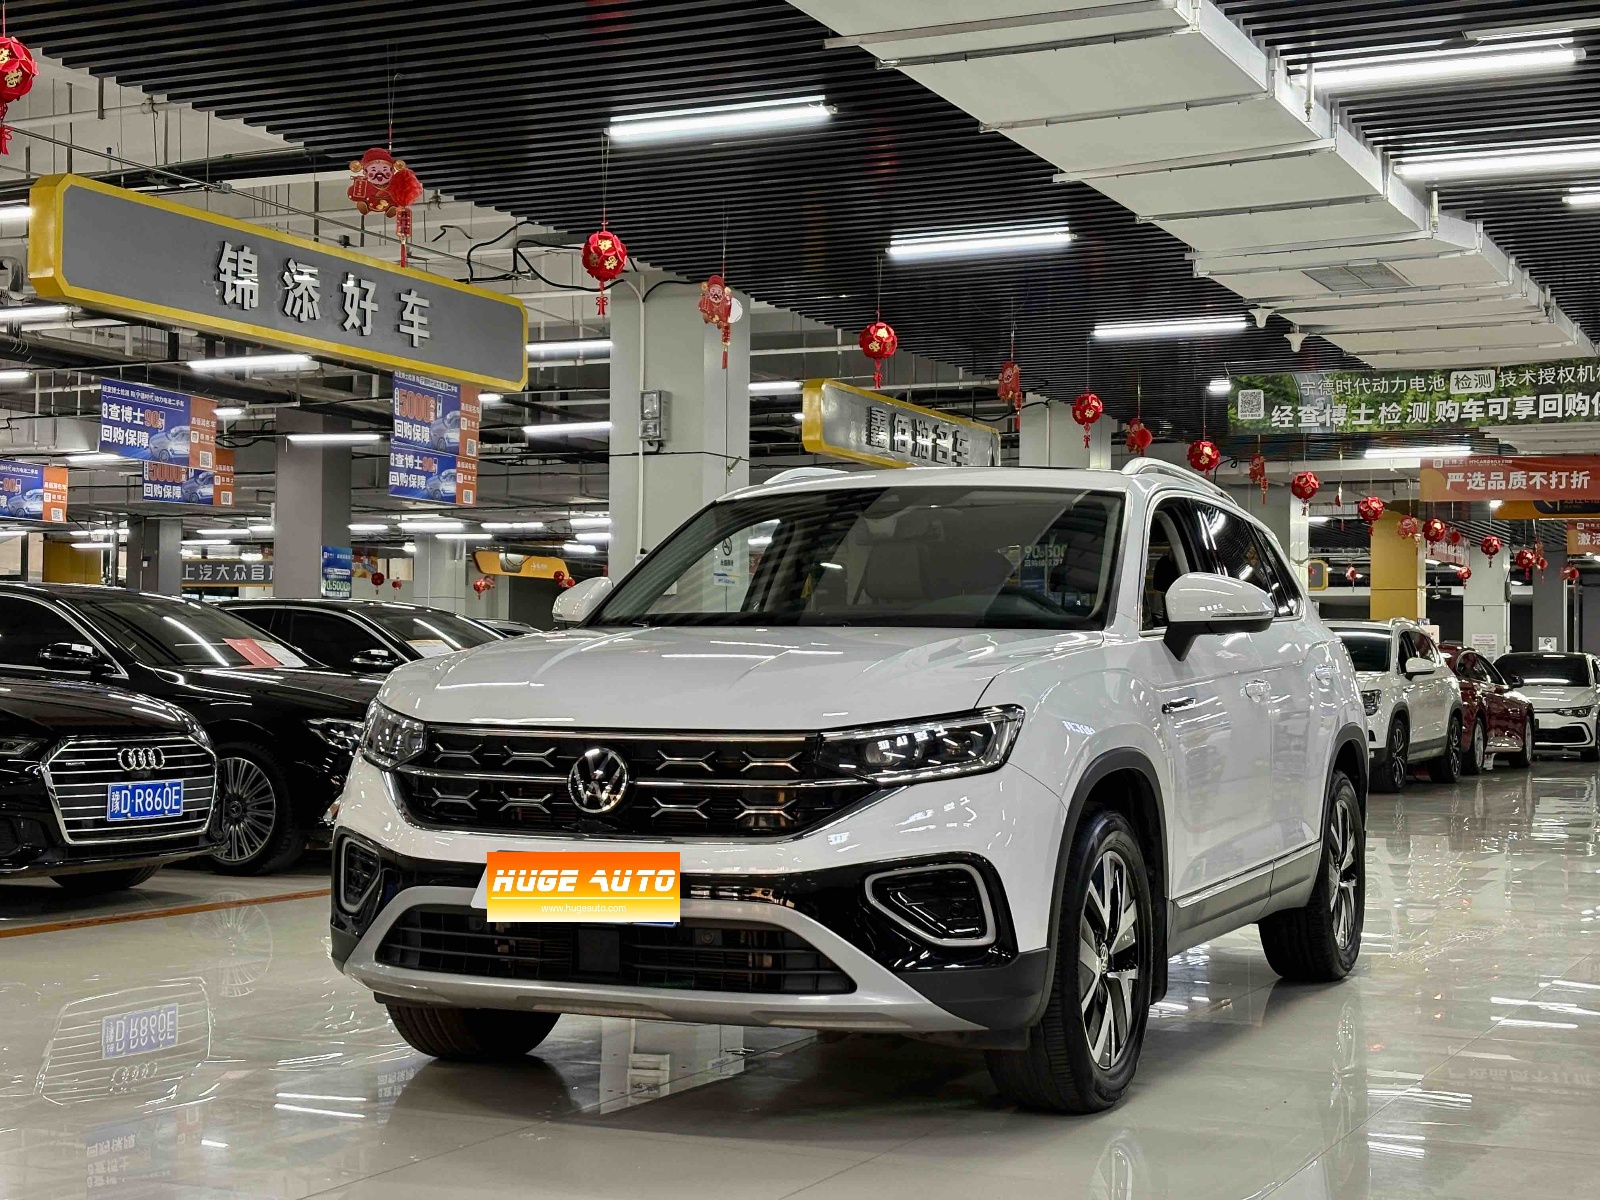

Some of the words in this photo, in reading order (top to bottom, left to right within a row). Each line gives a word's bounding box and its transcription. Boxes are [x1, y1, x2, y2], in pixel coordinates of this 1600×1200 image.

[218, 241, 430, 348] 锦添好车
[1300, 375, 1446, 396] 宁德时代动力电池
[1454, 372, 1492, 390] 检测
[1499, 364, 1600, 388] 技术授权机
[101, 424, 150, 450] 回购保障
[143, 482, 182, 500] 回购保障
[1446, 471, 1591, 490] 严选品质不打折
